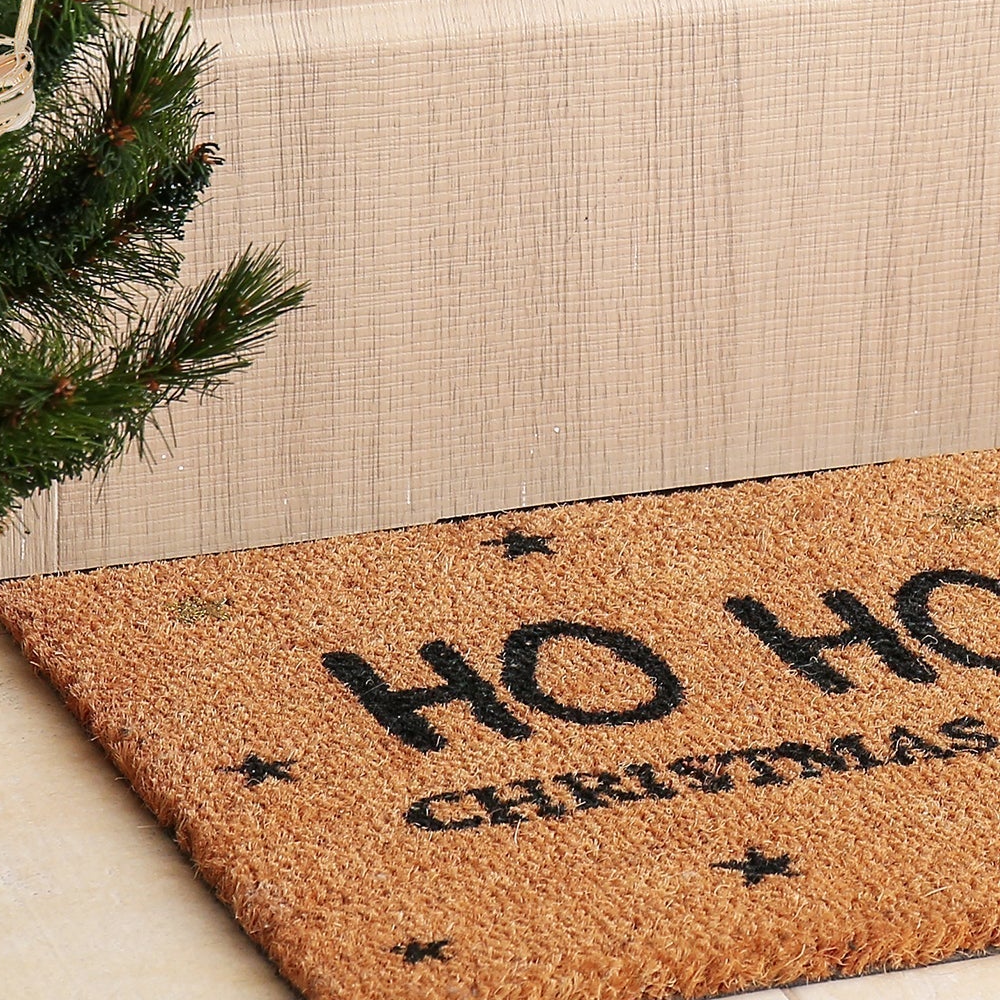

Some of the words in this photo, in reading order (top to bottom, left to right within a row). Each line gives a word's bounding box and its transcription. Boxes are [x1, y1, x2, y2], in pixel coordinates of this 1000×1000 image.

[322, 620, 684, 753] HO
[724, 568, 1000, 694] HO
[404, 717, 999, 831] CHRISTMAS
